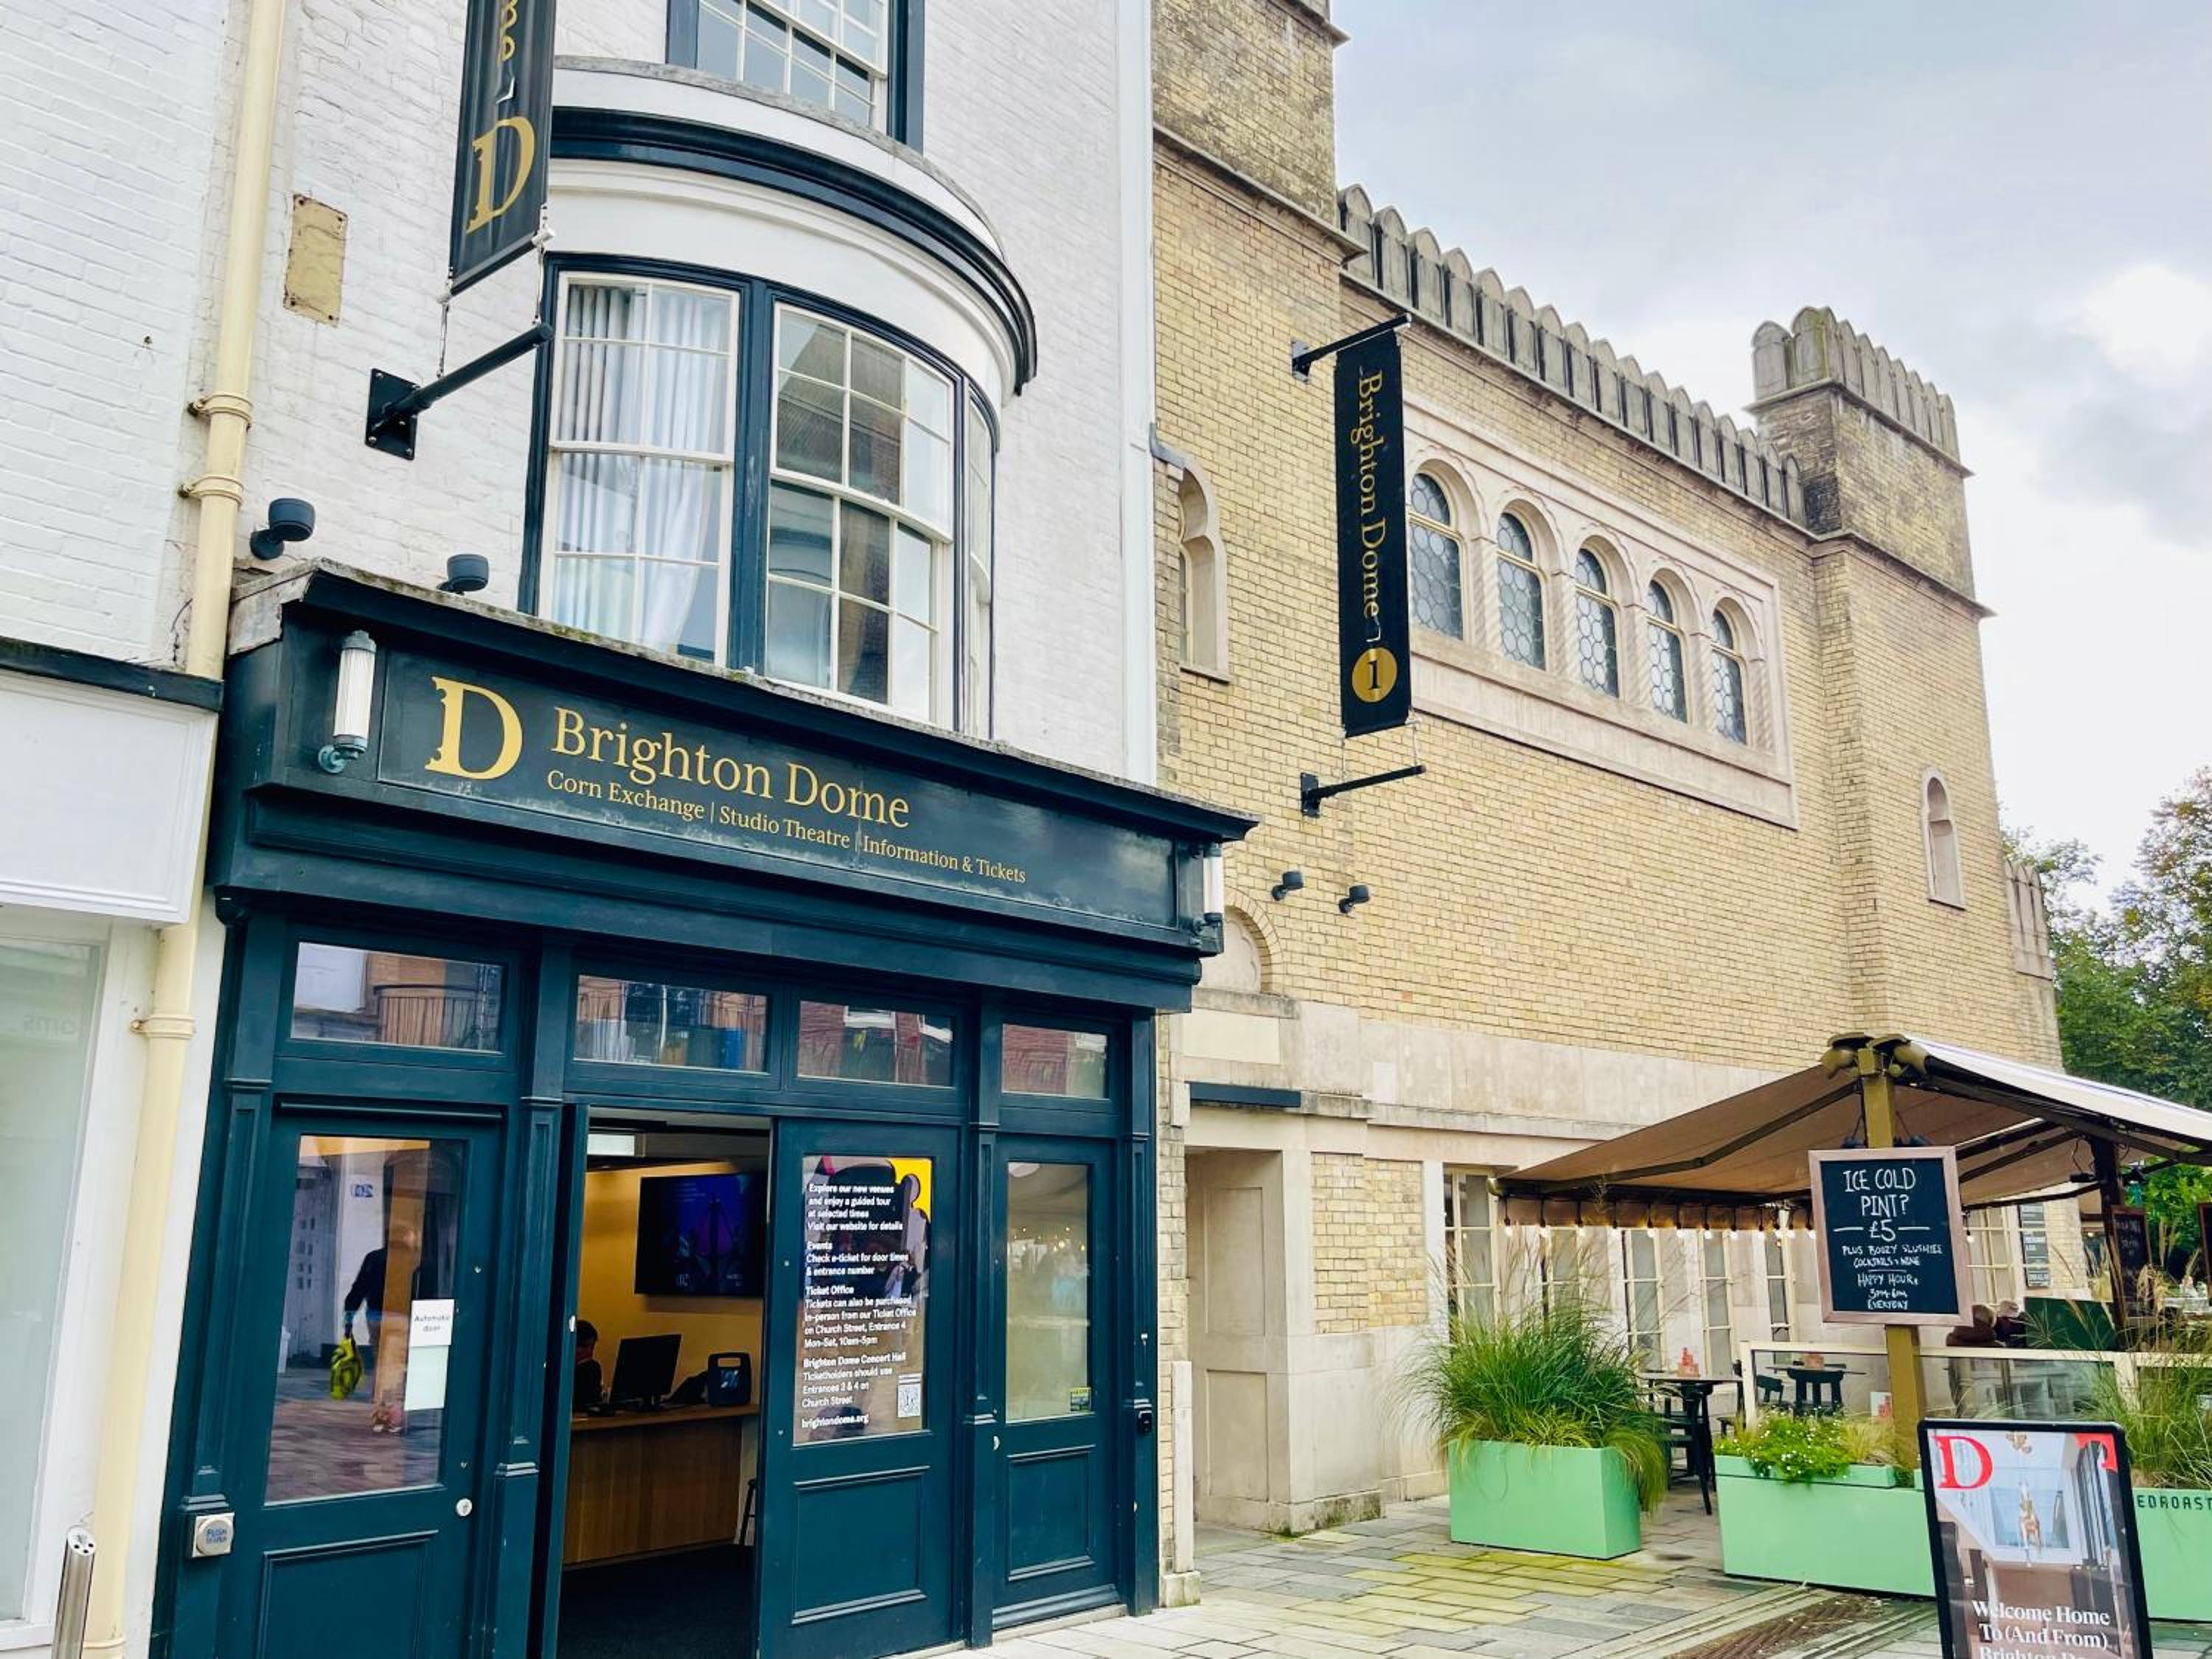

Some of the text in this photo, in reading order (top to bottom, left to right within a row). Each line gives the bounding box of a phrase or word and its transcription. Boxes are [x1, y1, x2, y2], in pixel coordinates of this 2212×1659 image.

[466, 116, 535, 235] D
[1351, 368, 1385, 619] Brighton Dome
[425, 676, 523, 780] D
[551, 706, 909, 828] Brighton Dome
[547, 770, 1026, 884] Corn Exchange Studio Theatre Information & Tickets
[1843, 1167, 1916, 1192] ICE COLD
[809, 1183, 838, 1194] Explore
[808, 1197, 823, 1206] and
[824, 1196, 844, 1207] enjoy
[851, 1196, 875, 1207] guided
[876, 1197, 891, 1206] tour
[1860, 1194, 1910, 1217] PINT?
[817, 1209, 849, 1219] selected
[849, 1209, 869, 1219] times
[807, 1222, 825, 1231] Visit
[839, 1221, 868, 1231] website
[869, 1221, 880, 1231] for
[880, 1220, 903, 1231] details
[1868, 1219, 1896, 1242] £5
[806, 1251, 909, 1263] Check e-ticket for door times
[1841, 1245, 1863, 1256] PLUS
[1868, 1244, 1898, 1255] BOOZY
[813, 1267, 846, 1276] entrance
[847, 1265, 875, 1275] number
[1857, 1272, 1885, 1287] HAPPY
[804, 1284, 855, 1295] Ticket Office
[804, 1298, 832, 1309] Tickets
[833, 1300, 847, 1308] can
[848, 1298, 864, 1307] also
[865, 1296, 874, 1306] be
[841, 1311, 858, 1320] from
[859, 1312, 872, 1320] our
[872, 1308, 894, 1318] Ticket
[895, 1307, 917, 1318] Office
[815, 1324, 843, 1335] Church
[869, 1321, 900, 1332] Entrance
[803, 1352, 906, 1368] Brighton Dome Concert Hall
[801, 1395, 853, 1408] Church Street
[801, 1413, 869, 1429] brightondome.org
[1932, 1435, 1994, 1489] D
[1972, 1599, 2110, 1626] Welcome Home
[1978, 1623, 2108, 1651] To (And From)
